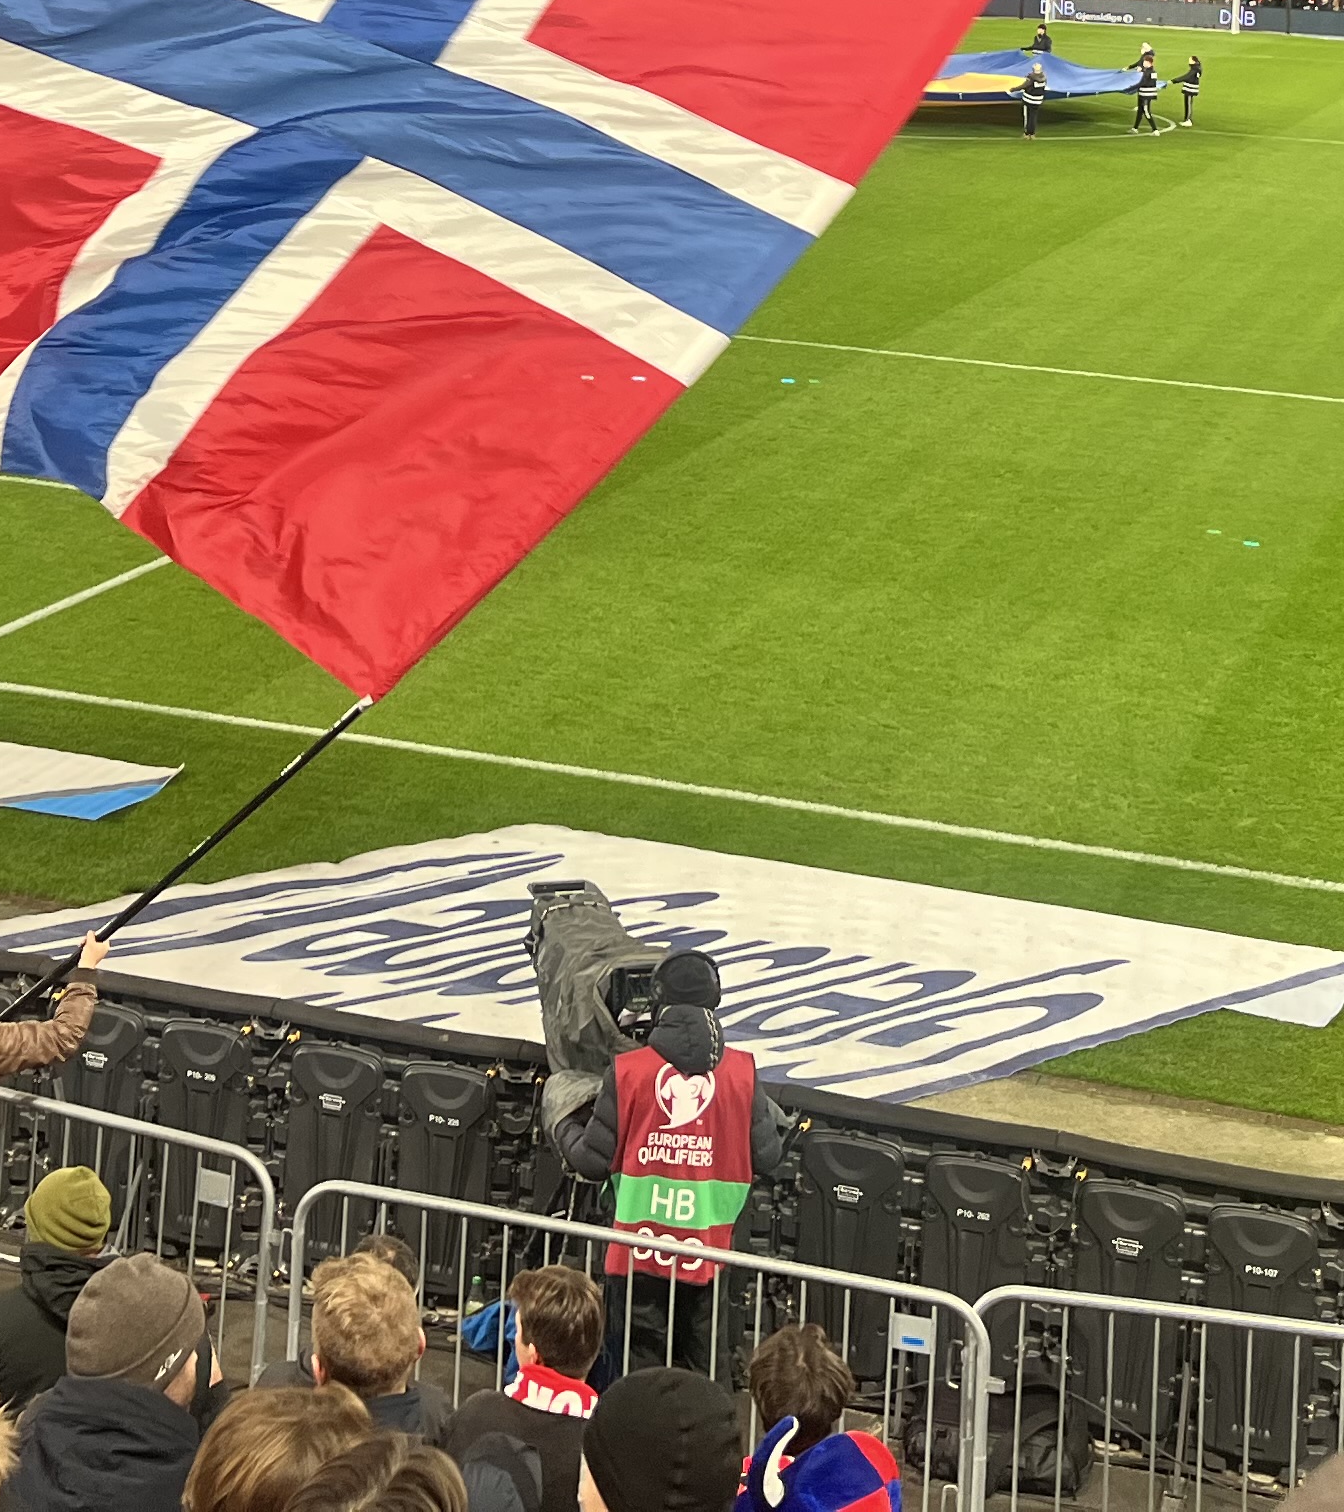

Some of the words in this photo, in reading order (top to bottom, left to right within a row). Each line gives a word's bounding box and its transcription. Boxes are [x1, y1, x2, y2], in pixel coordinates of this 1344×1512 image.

[647, 1131, 713, 1151] EUROPEAN
[637, 1146, 713, 1168] QUALIFIERS
[650, 1183, 696, 1222] HB
